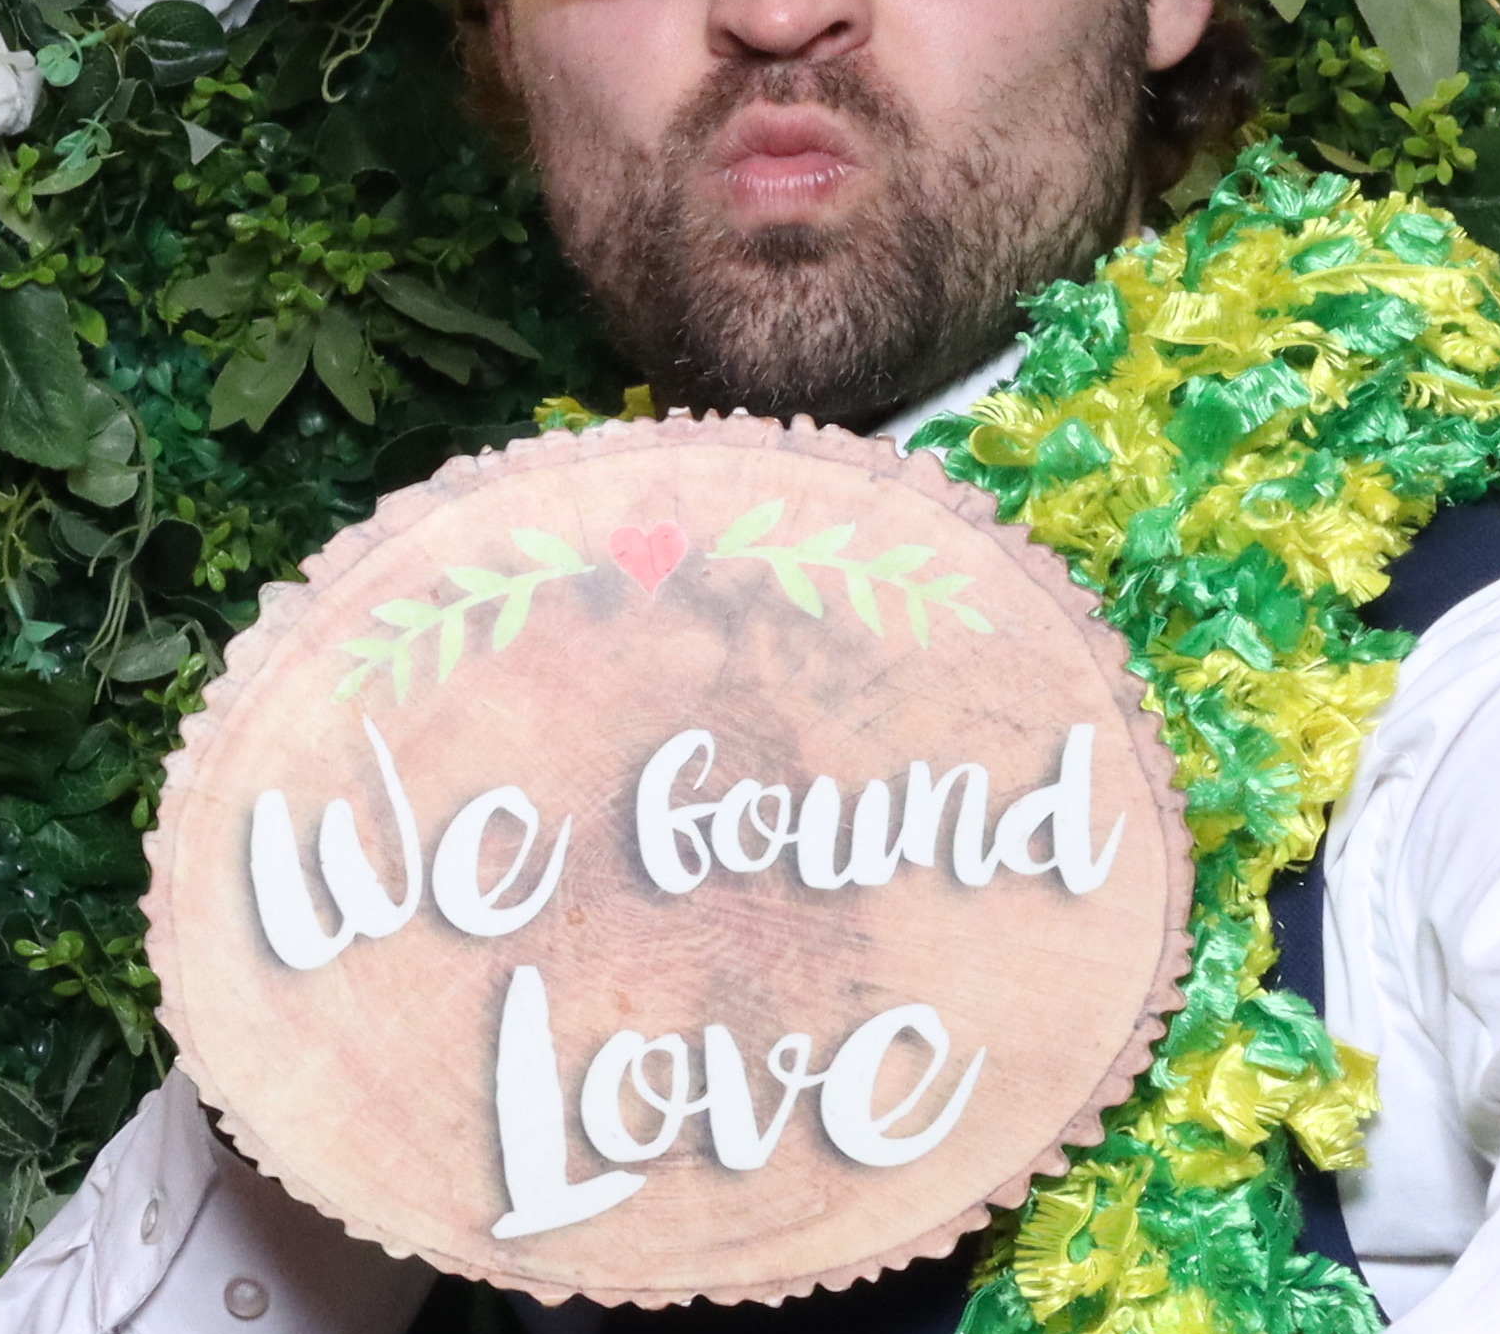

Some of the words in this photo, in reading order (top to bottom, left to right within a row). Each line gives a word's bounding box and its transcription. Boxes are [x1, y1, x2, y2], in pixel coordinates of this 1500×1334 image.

[249, 713, 572, 970] We
[636, 723, 1126, 894] found
[492, 965, 986, 1239] Love
